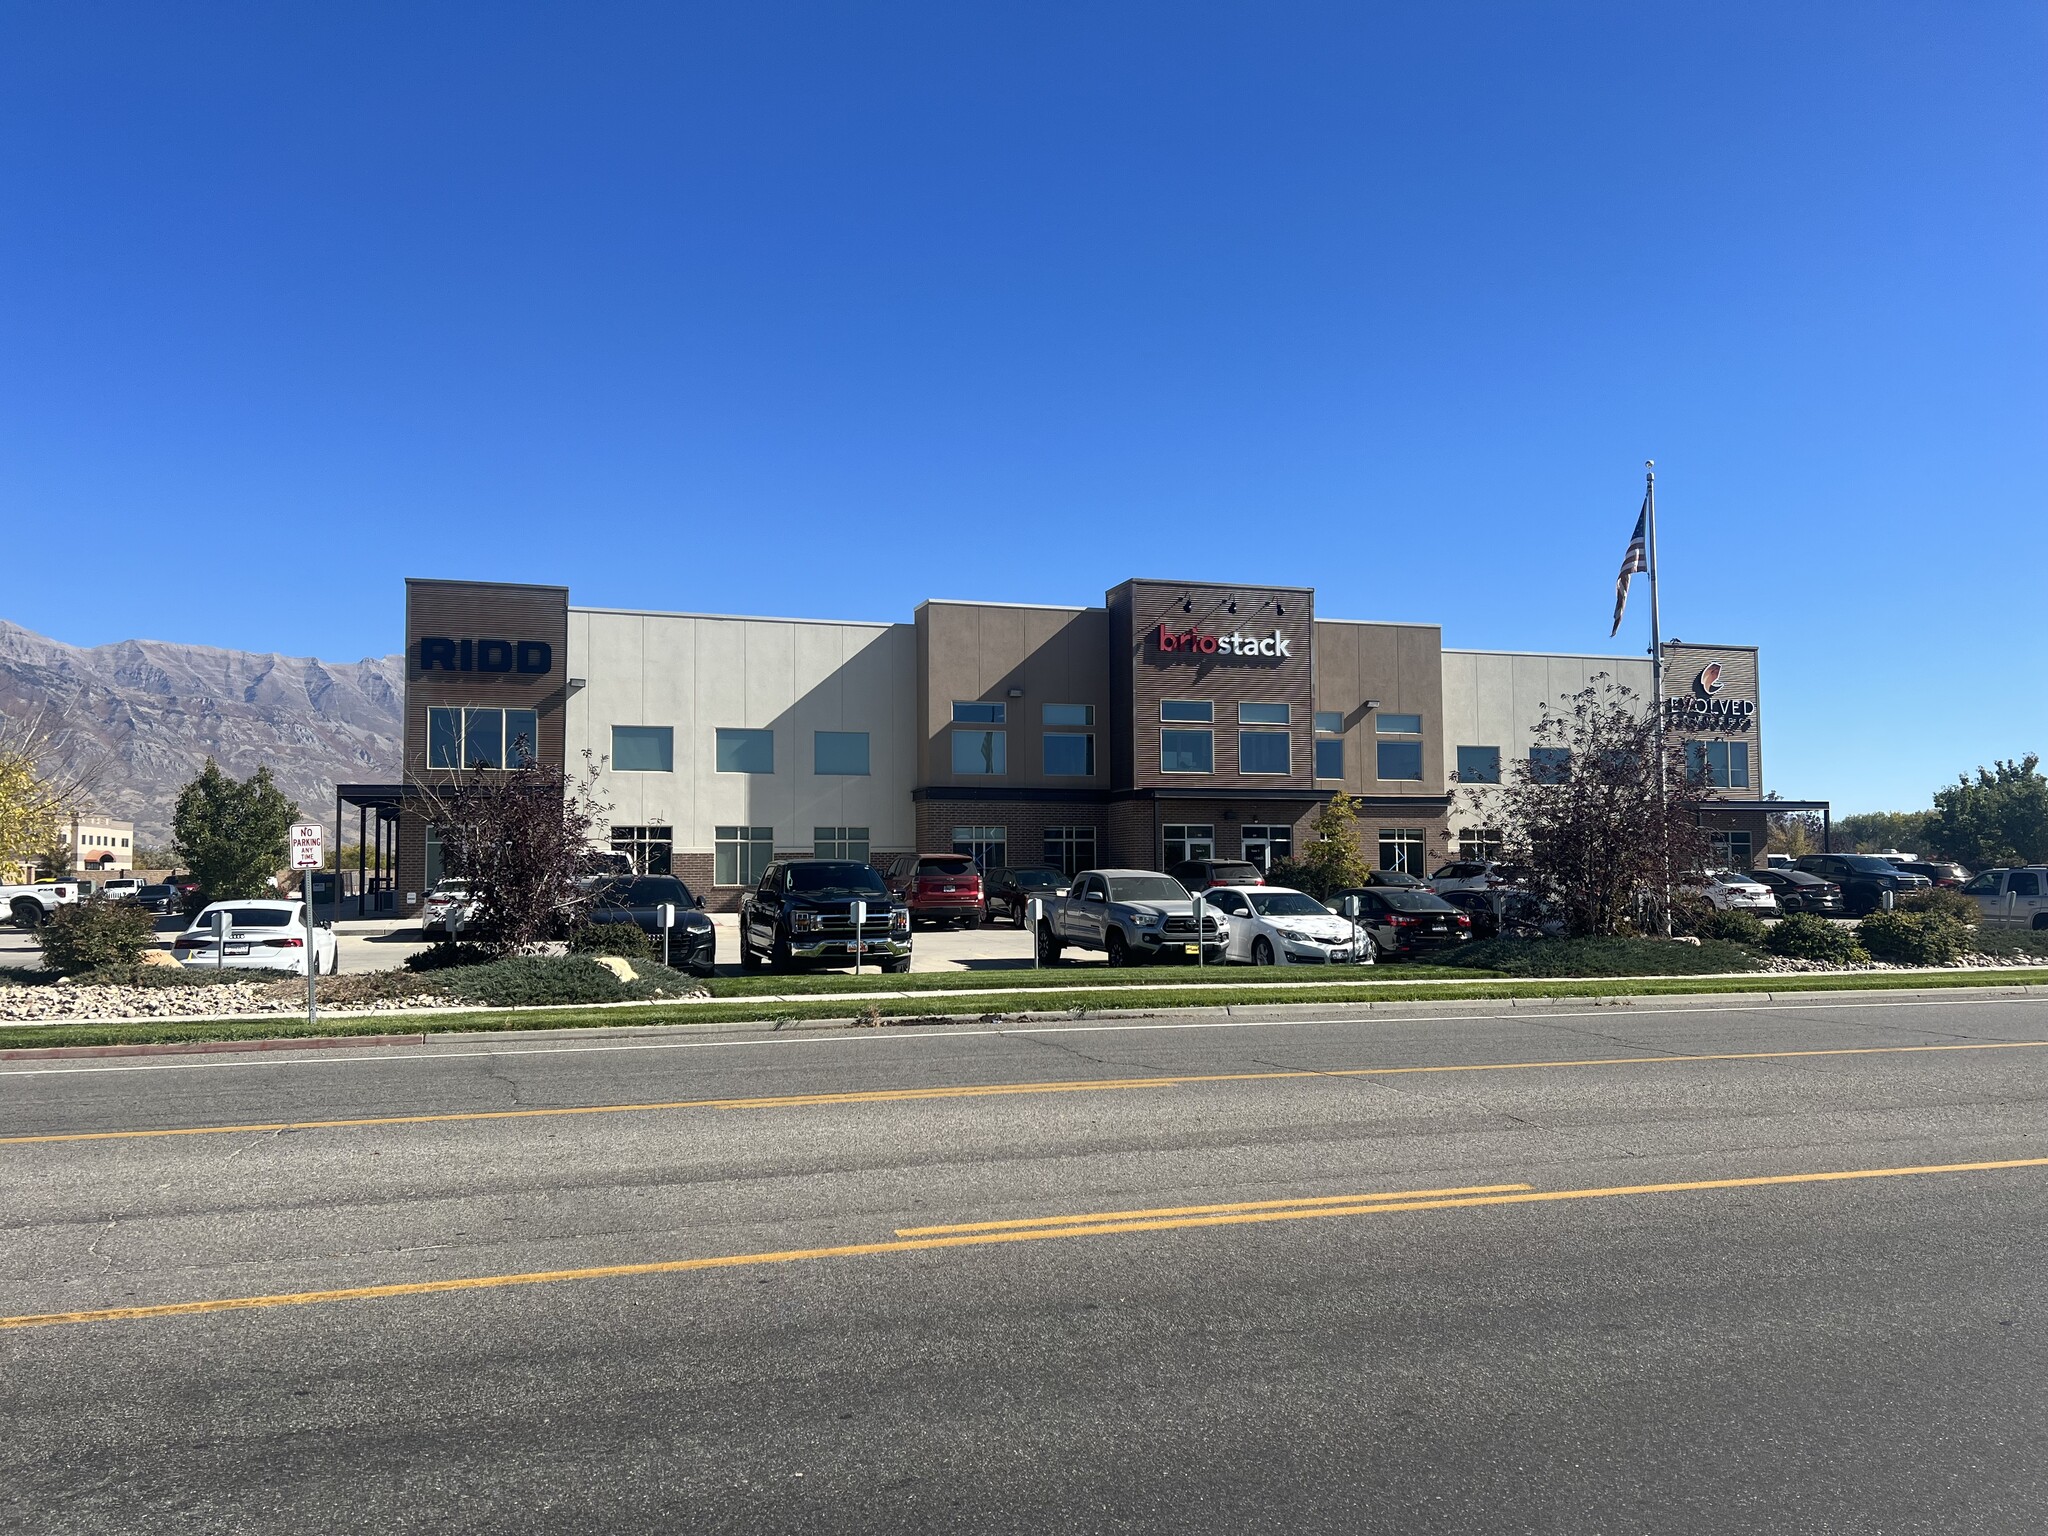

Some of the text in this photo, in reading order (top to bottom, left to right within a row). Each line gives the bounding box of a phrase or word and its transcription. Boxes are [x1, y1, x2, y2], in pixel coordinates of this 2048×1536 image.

[1160, 623, 1291, 657] briostack
[421, 638, 551, 674] RIDD
[293, 838, 321, 846] PARKING
[300, 828, 313, 837] NO
